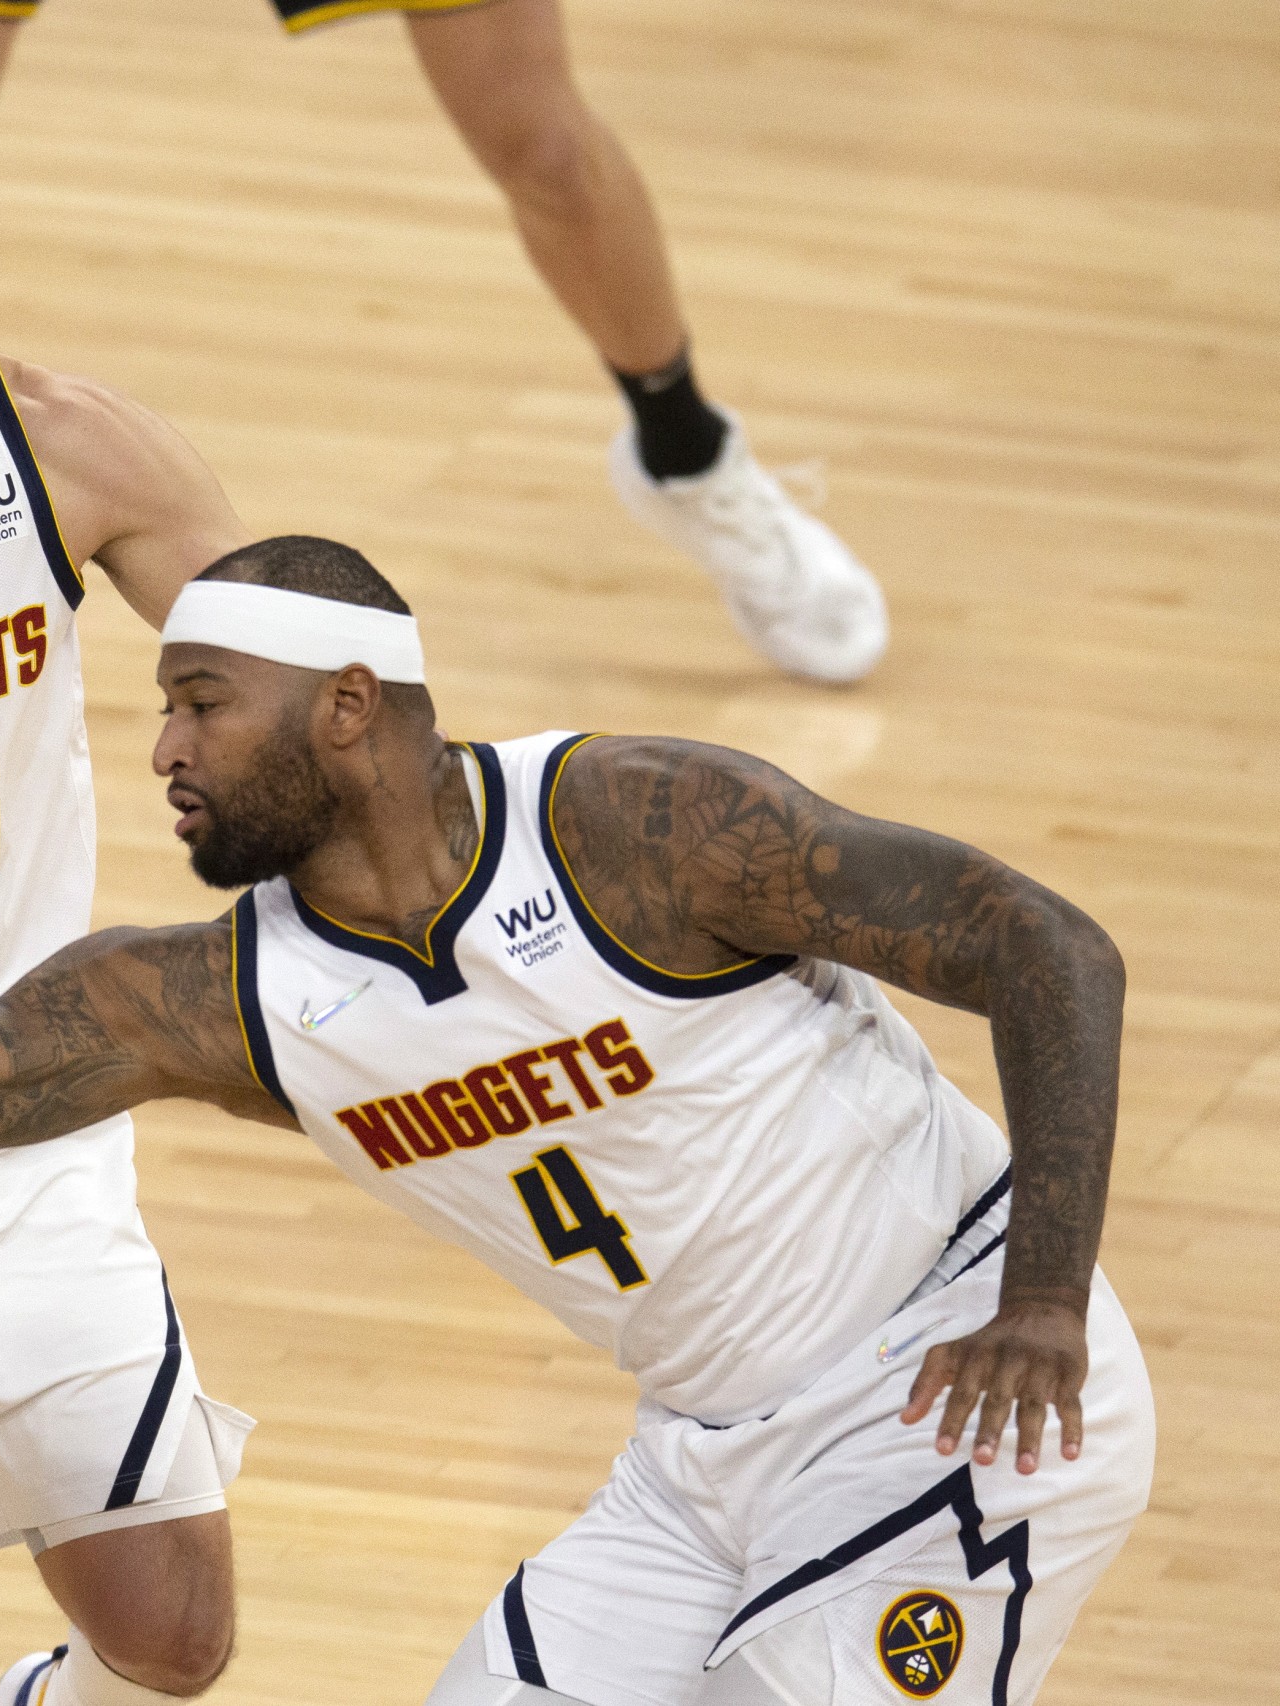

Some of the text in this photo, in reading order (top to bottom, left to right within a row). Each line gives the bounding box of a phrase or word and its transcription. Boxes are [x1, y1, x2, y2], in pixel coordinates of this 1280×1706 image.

[495, 889, 557, 939] WU
[505, 923, 567, 957] Western
[522, 941, 563, 967] Union
[334, 1017, 655, 1171] NUGGETS
[508, 1144, 650, 1294] 4
